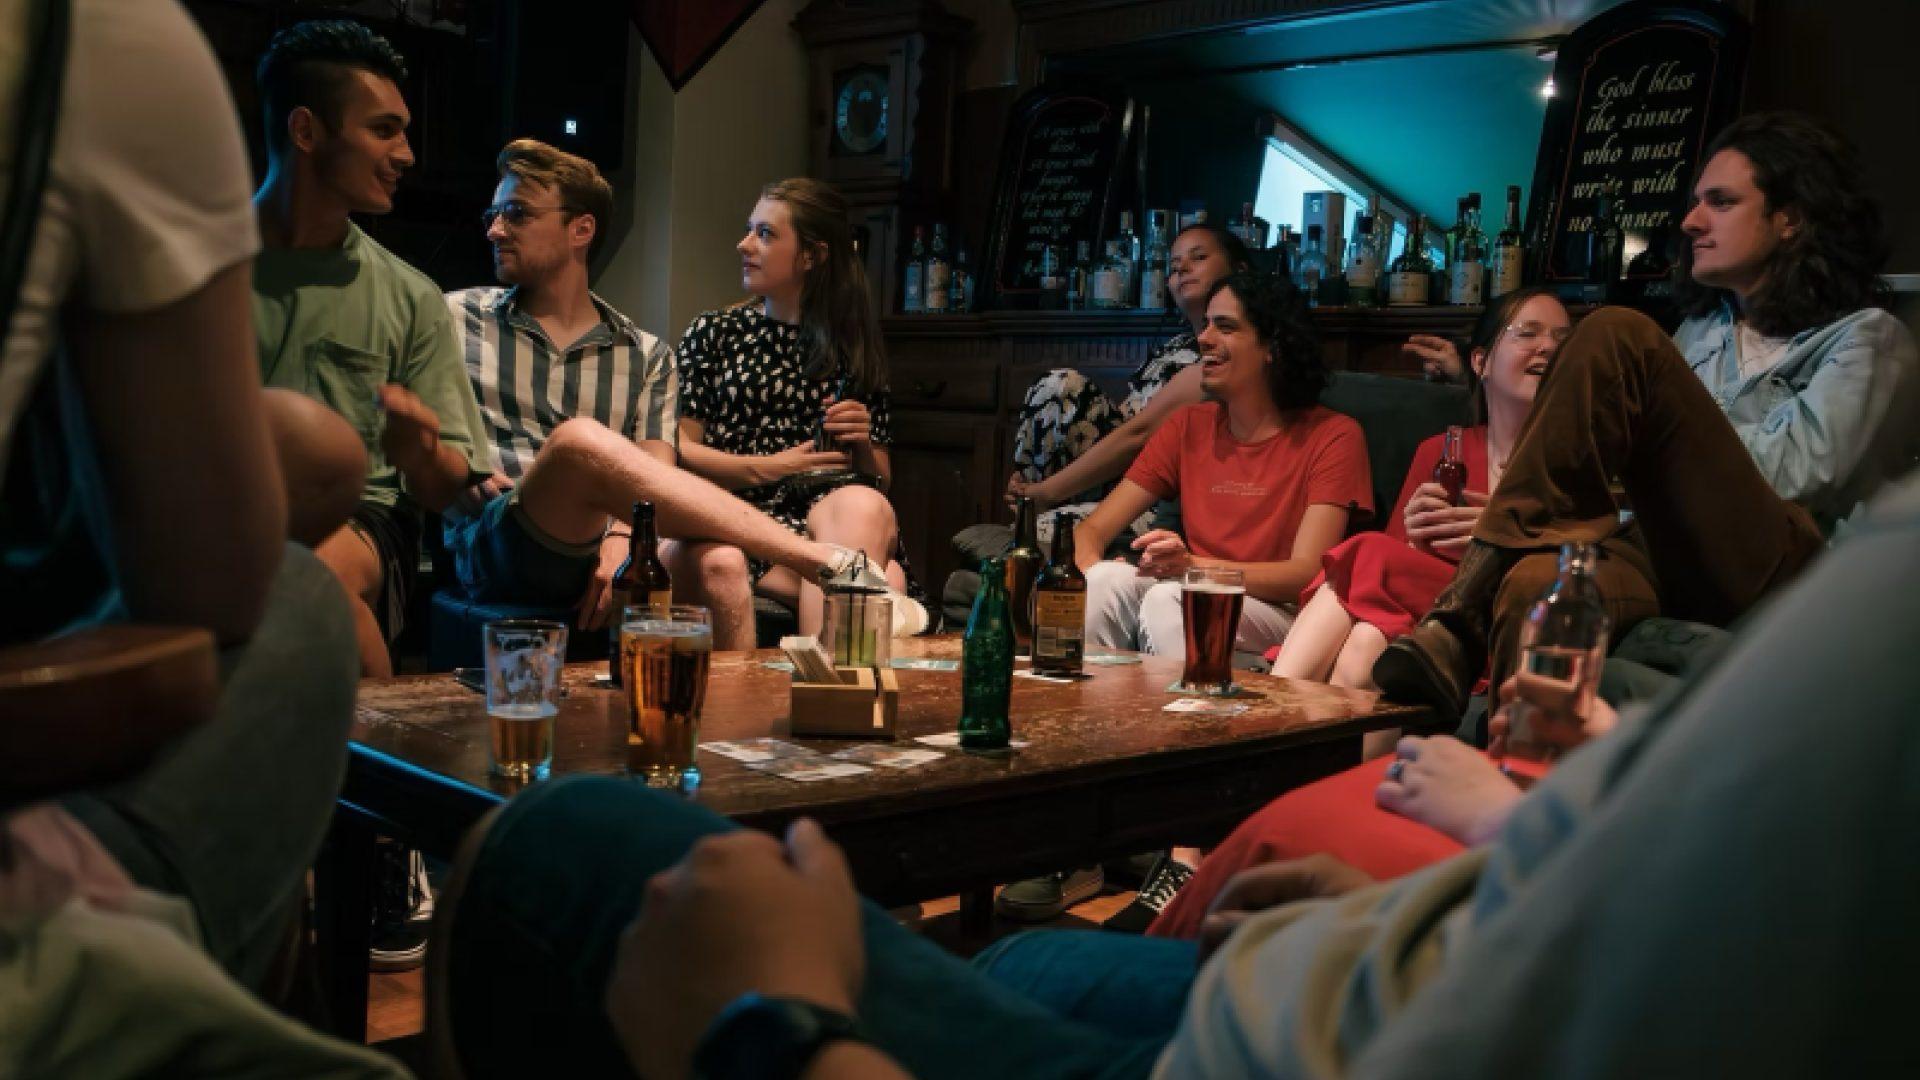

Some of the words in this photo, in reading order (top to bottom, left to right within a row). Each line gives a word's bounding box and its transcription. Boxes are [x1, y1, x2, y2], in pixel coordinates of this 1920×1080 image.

[1598, 65, 1650, 99] God
[1648, 60, 1696, 93] bless
[1585, 100, 1616, 134] the
[1622, 104, 1692, 129] sinner
[1582, 133, 1623, 165] who
[1631, 137, 1686, 162] must
[1632, 160, 1686, 194] with
[1611, 199, 1673, 229] inner.
